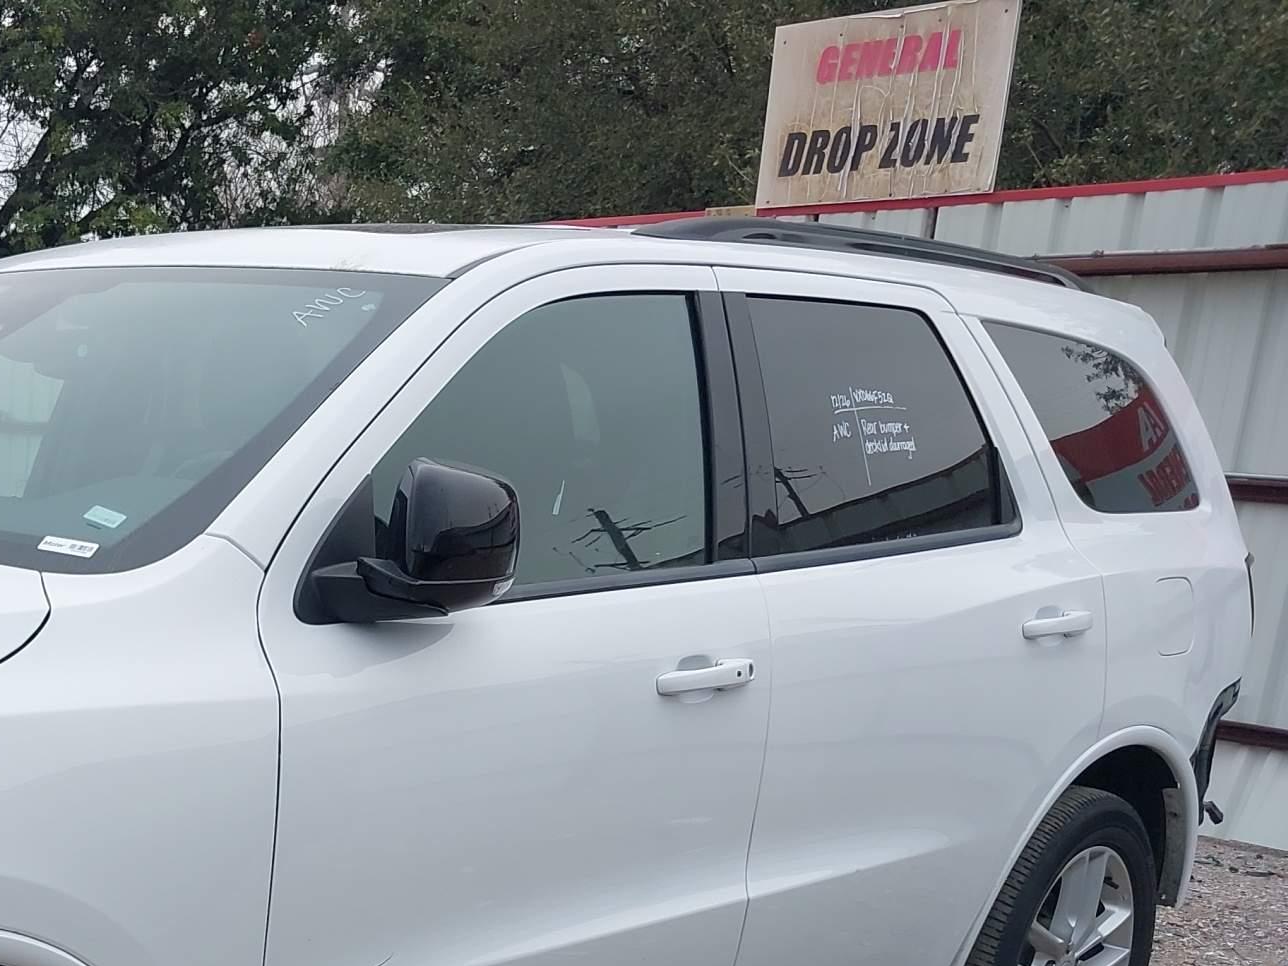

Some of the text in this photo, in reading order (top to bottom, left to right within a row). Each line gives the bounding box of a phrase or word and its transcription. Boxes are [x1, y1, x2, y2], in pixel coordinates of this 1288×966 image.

[816, 29, 963, 85] GENERAL
[777, 114, 980, 177] DROP ZONE
[292, 287, 366, 327] AWC
[878, 420, 903, 437] bumper
